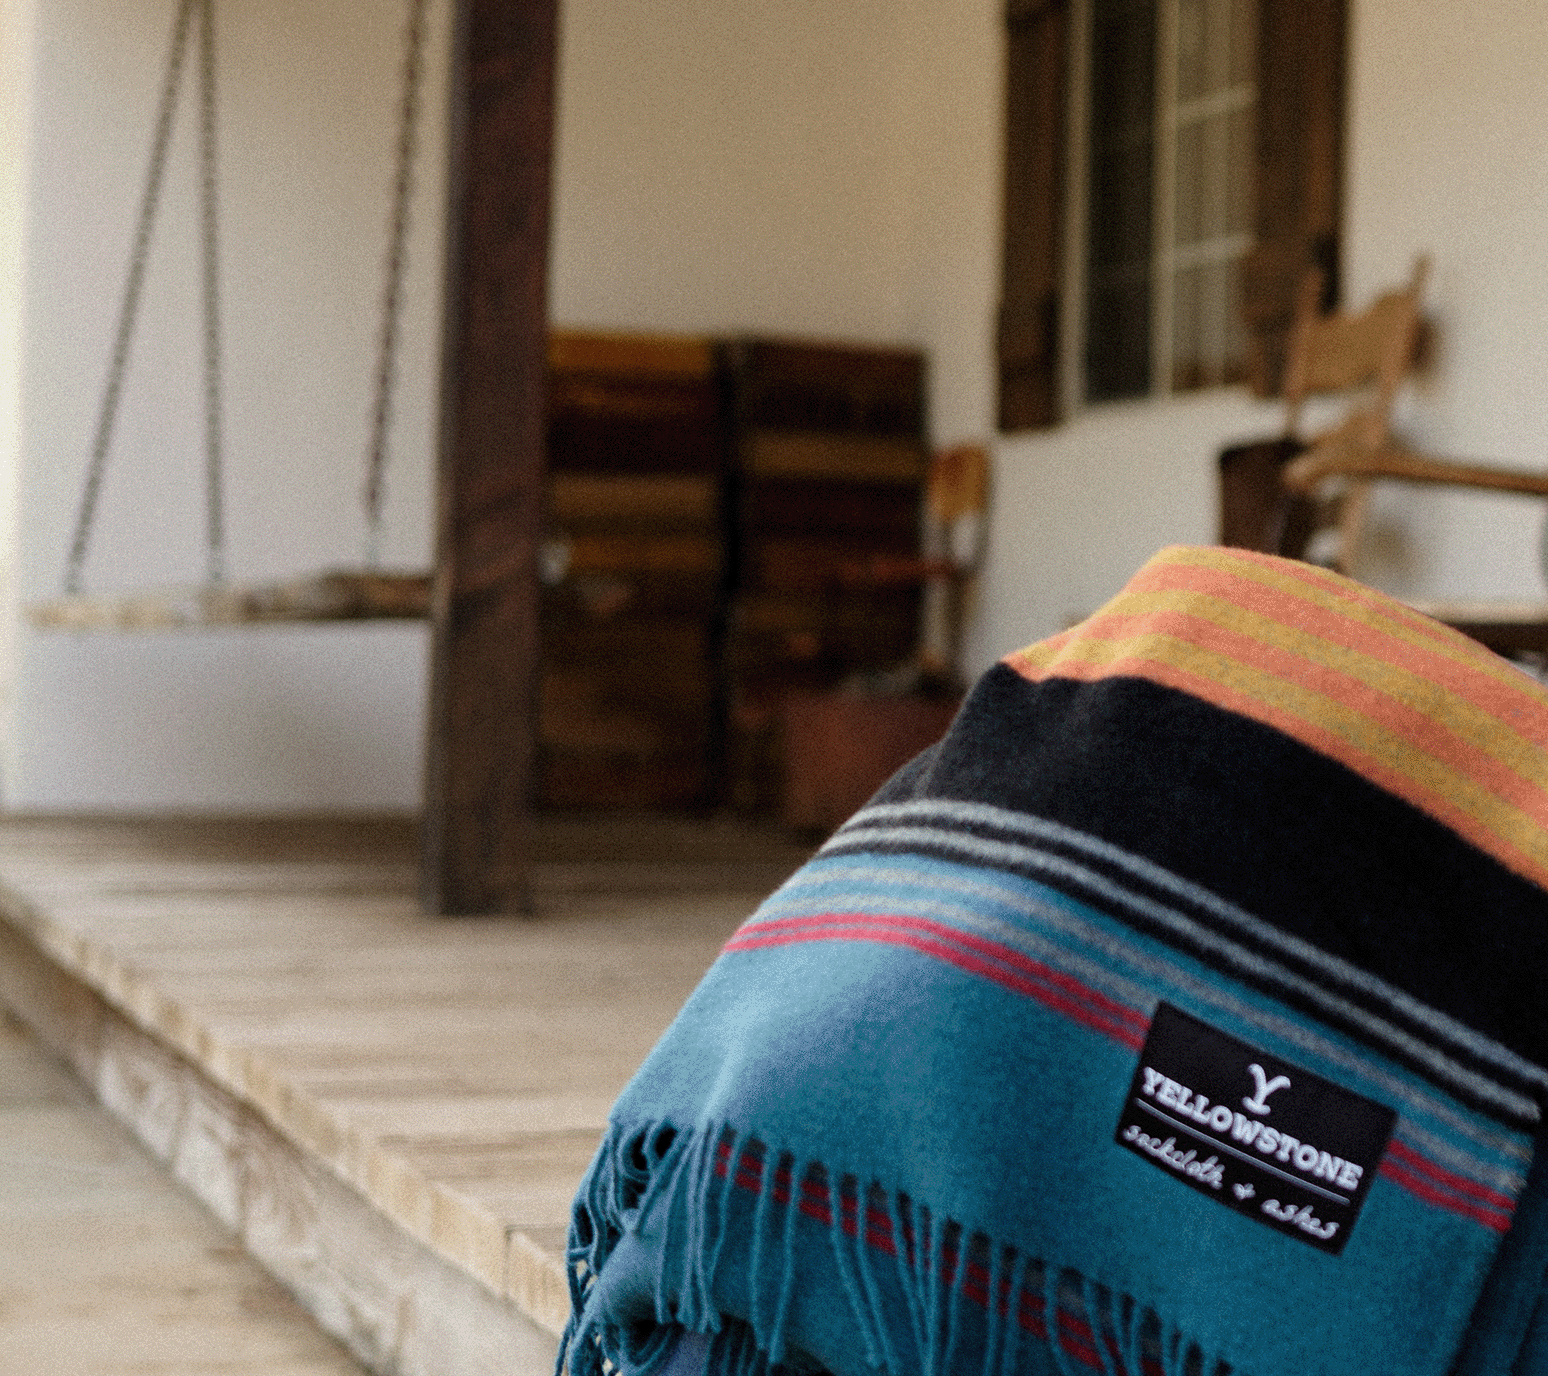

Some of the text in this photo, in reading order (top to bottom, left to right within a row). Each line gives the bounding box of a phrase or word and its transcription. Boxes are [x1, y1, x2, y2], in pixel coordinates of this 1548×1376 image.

[1243, 1063, 1291, 1115] Y
[1142, 1066, 1364, 1191] YELLOWSTONE
[1260, 1198, 1340, 1239] ashes
